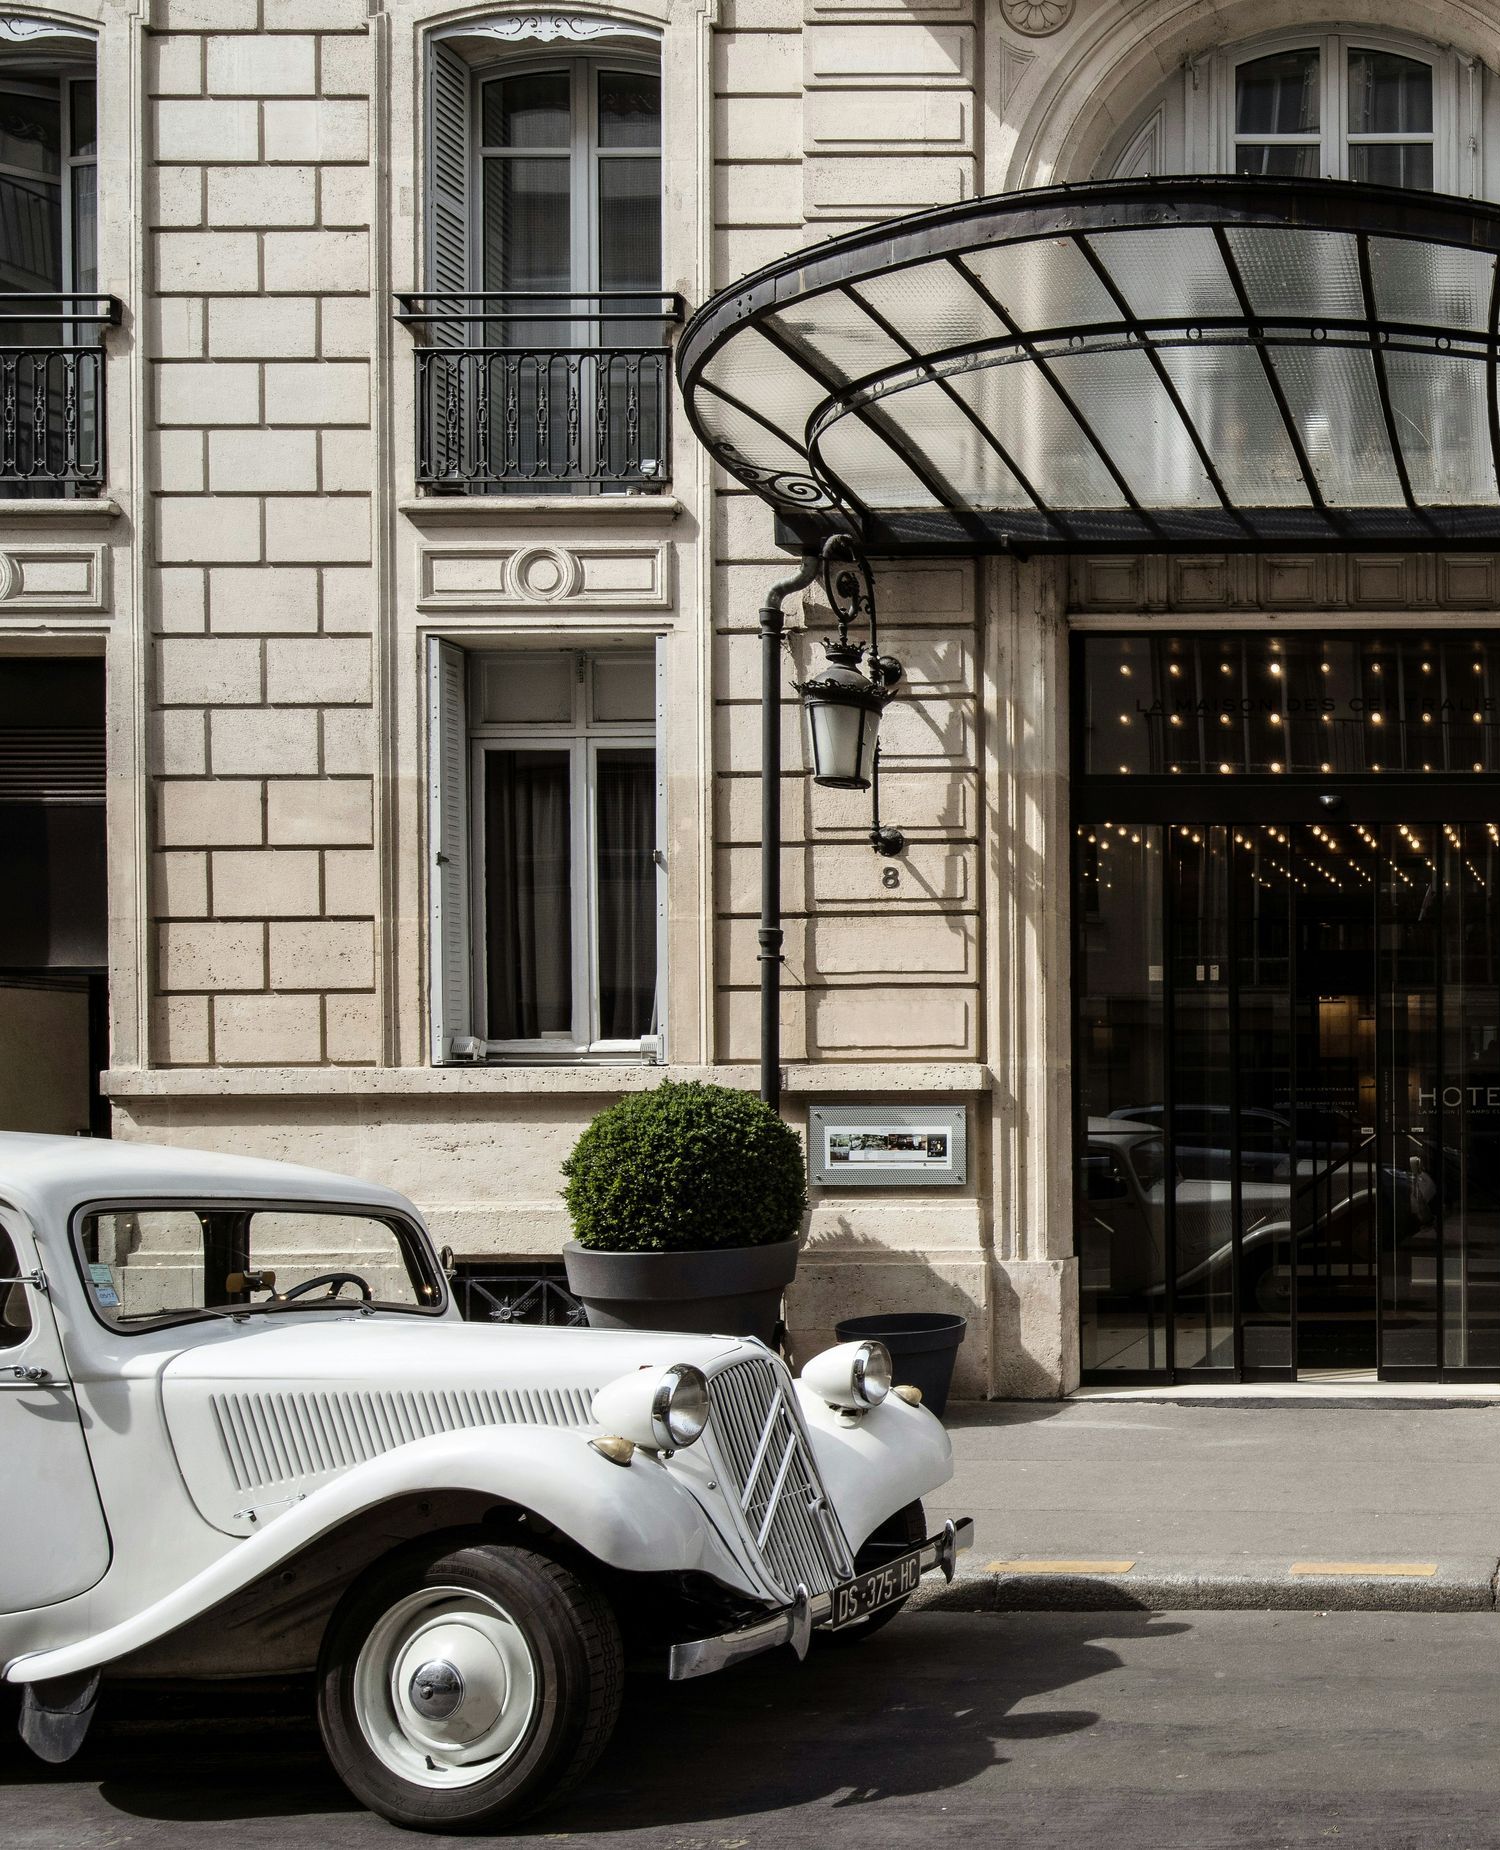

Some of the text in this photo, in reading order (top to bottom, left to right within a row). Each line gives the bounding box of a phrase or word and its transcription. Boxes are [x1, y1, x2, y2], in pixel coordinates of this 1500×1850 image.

[1135, 699, 1165, 713] LA
[1175, 698, 1273, 713] MAISON
[1287, 698, 1336, 712] DES
[882, 866, 900, 889] 8
